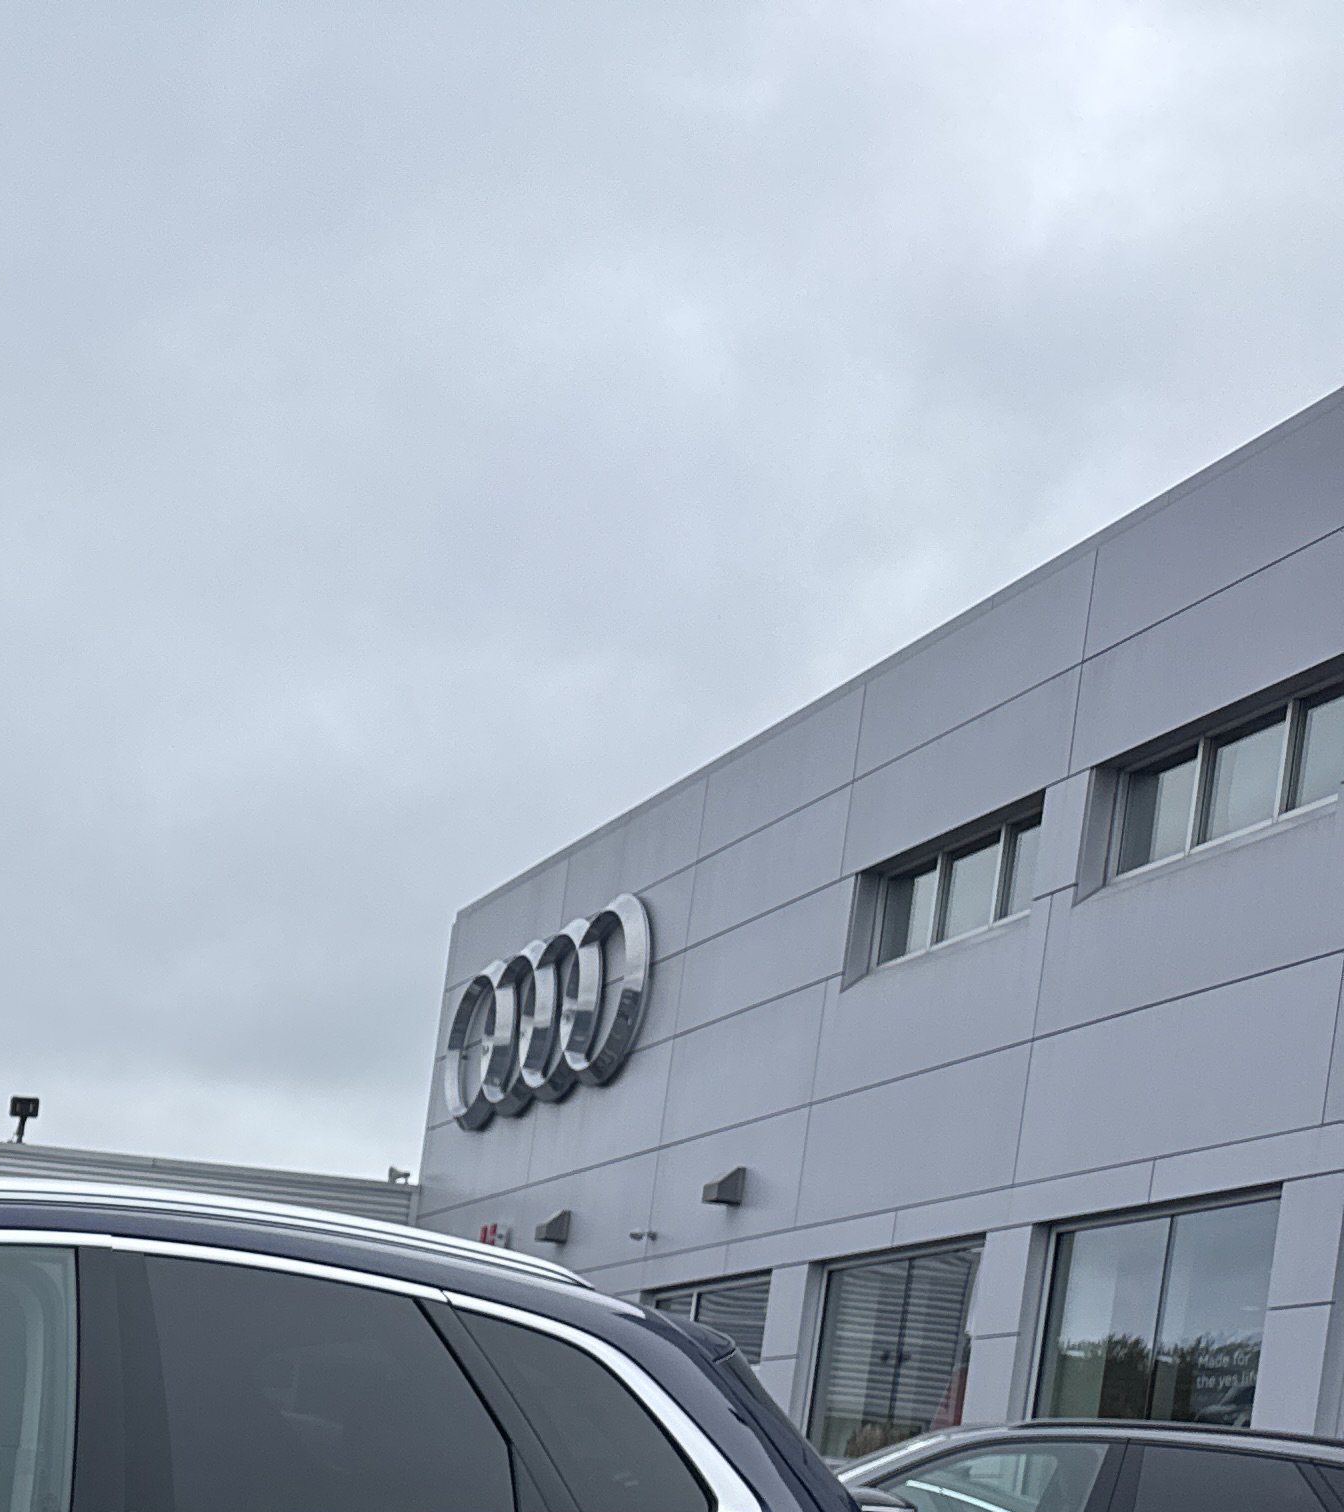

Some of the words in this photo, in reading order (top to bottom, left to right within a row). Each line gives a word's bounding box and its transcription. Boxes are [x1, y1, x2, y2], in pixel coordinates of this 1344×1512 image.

[1198, 1354, 1230, 1369] Made
[1233, 1349, 1251, 1367] for
[1196, 1375, 1216, 1390] the
